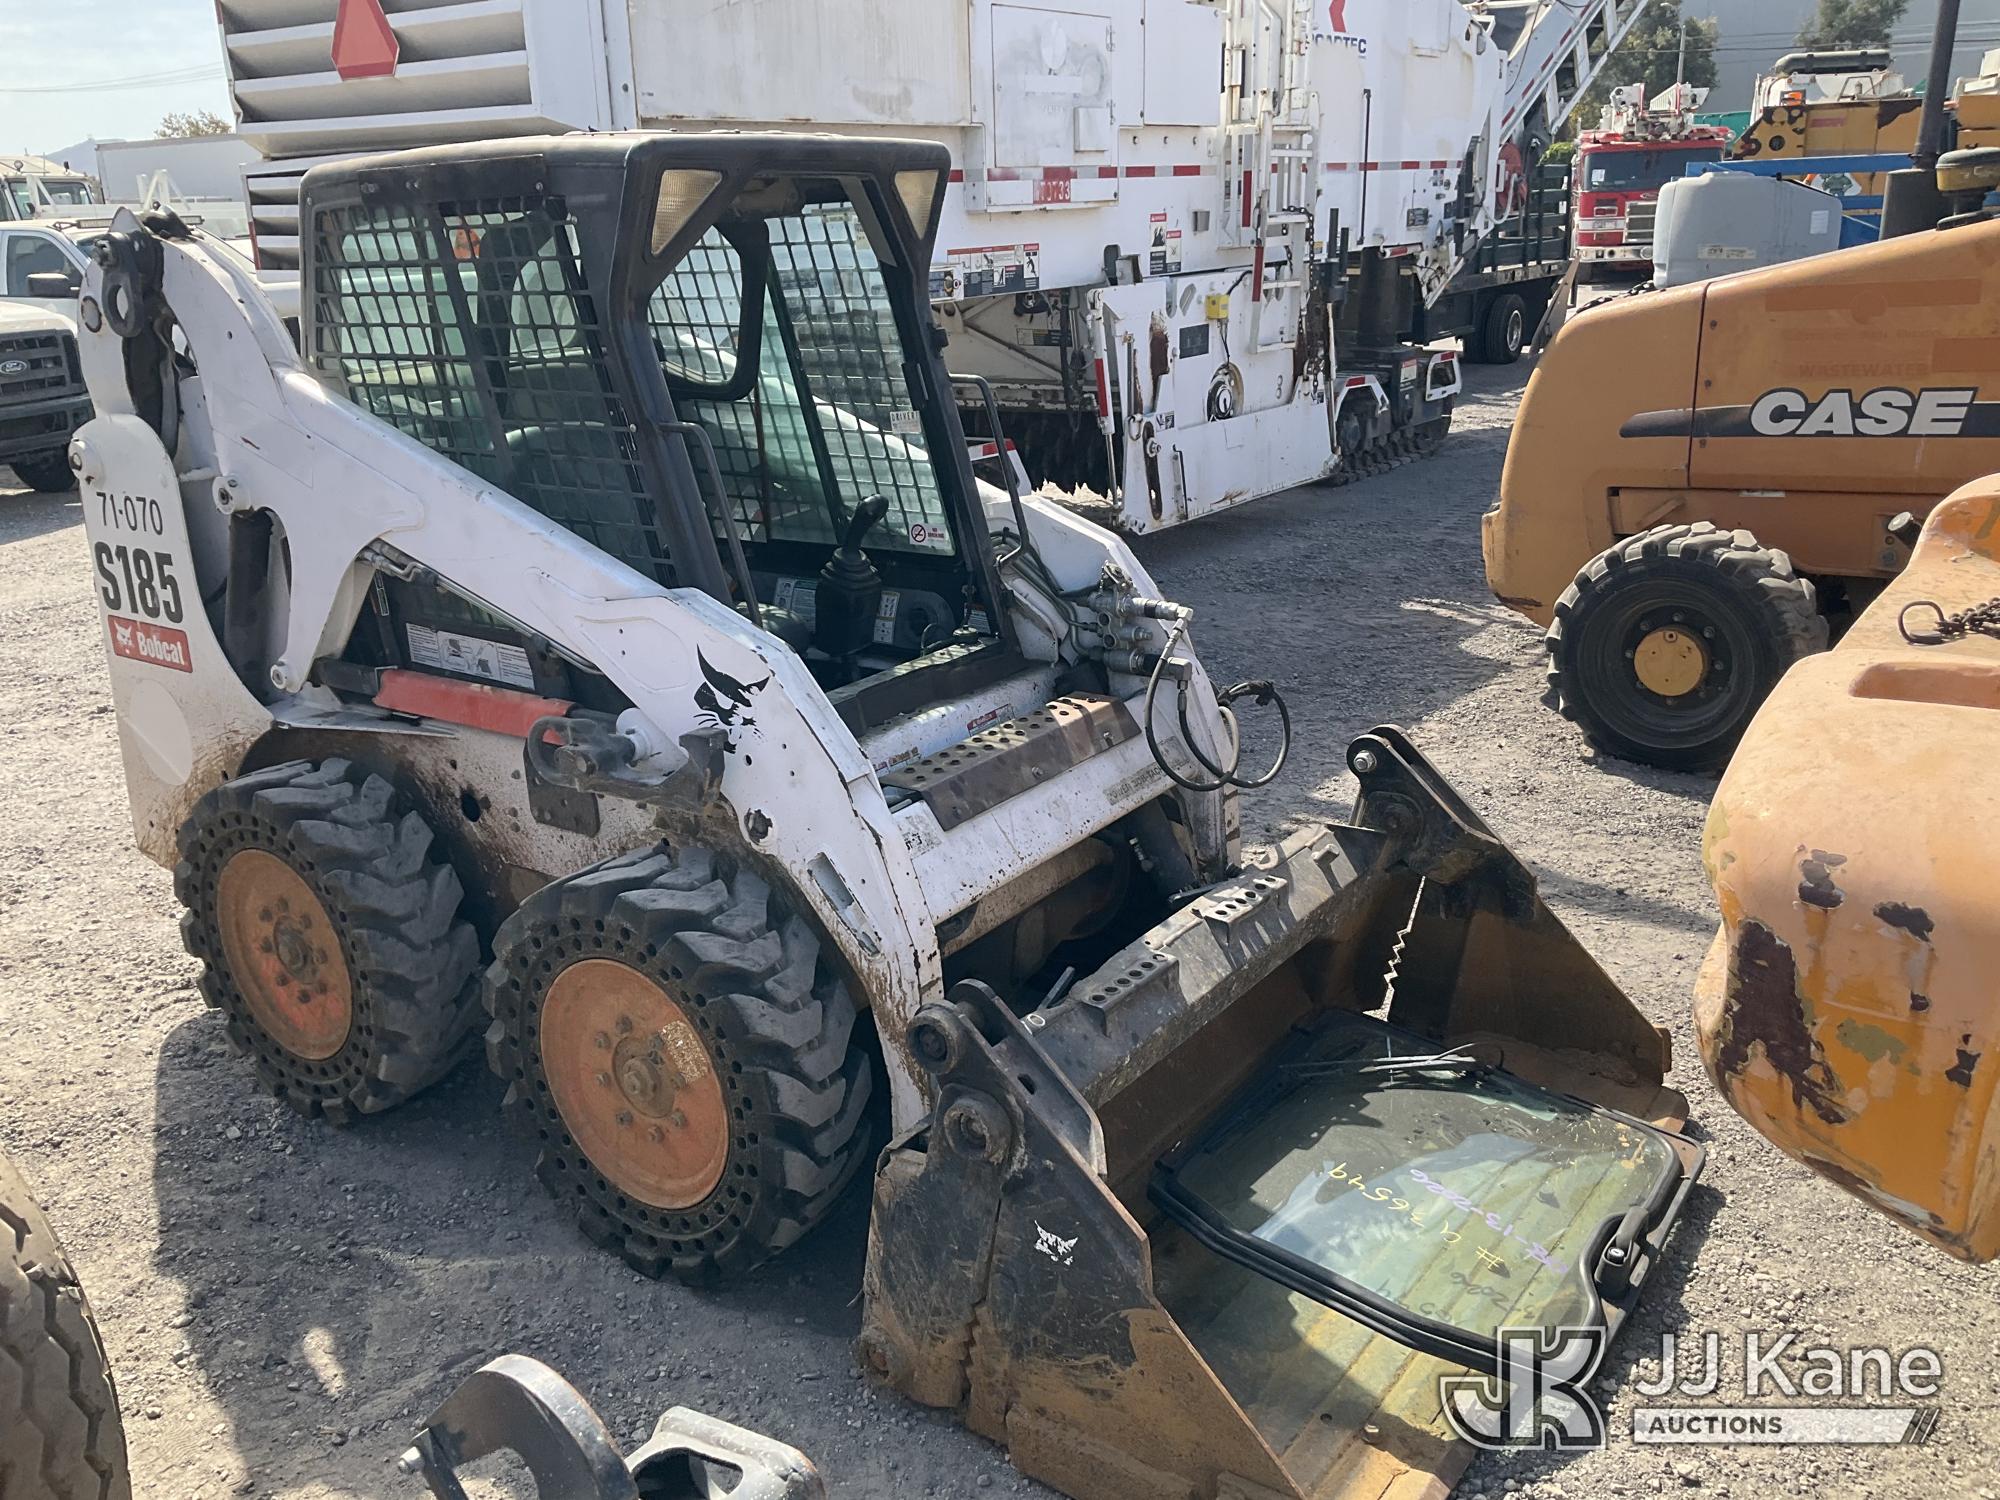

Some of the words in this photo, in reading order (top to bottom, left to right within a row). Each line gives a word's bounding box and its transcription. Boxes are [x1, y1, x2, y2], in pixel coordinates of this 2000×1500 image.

[1750, 389, 1976, 436] CASE
[94, 541, 184, 624] S185
[136, 631, 186, 666] Bobcat
